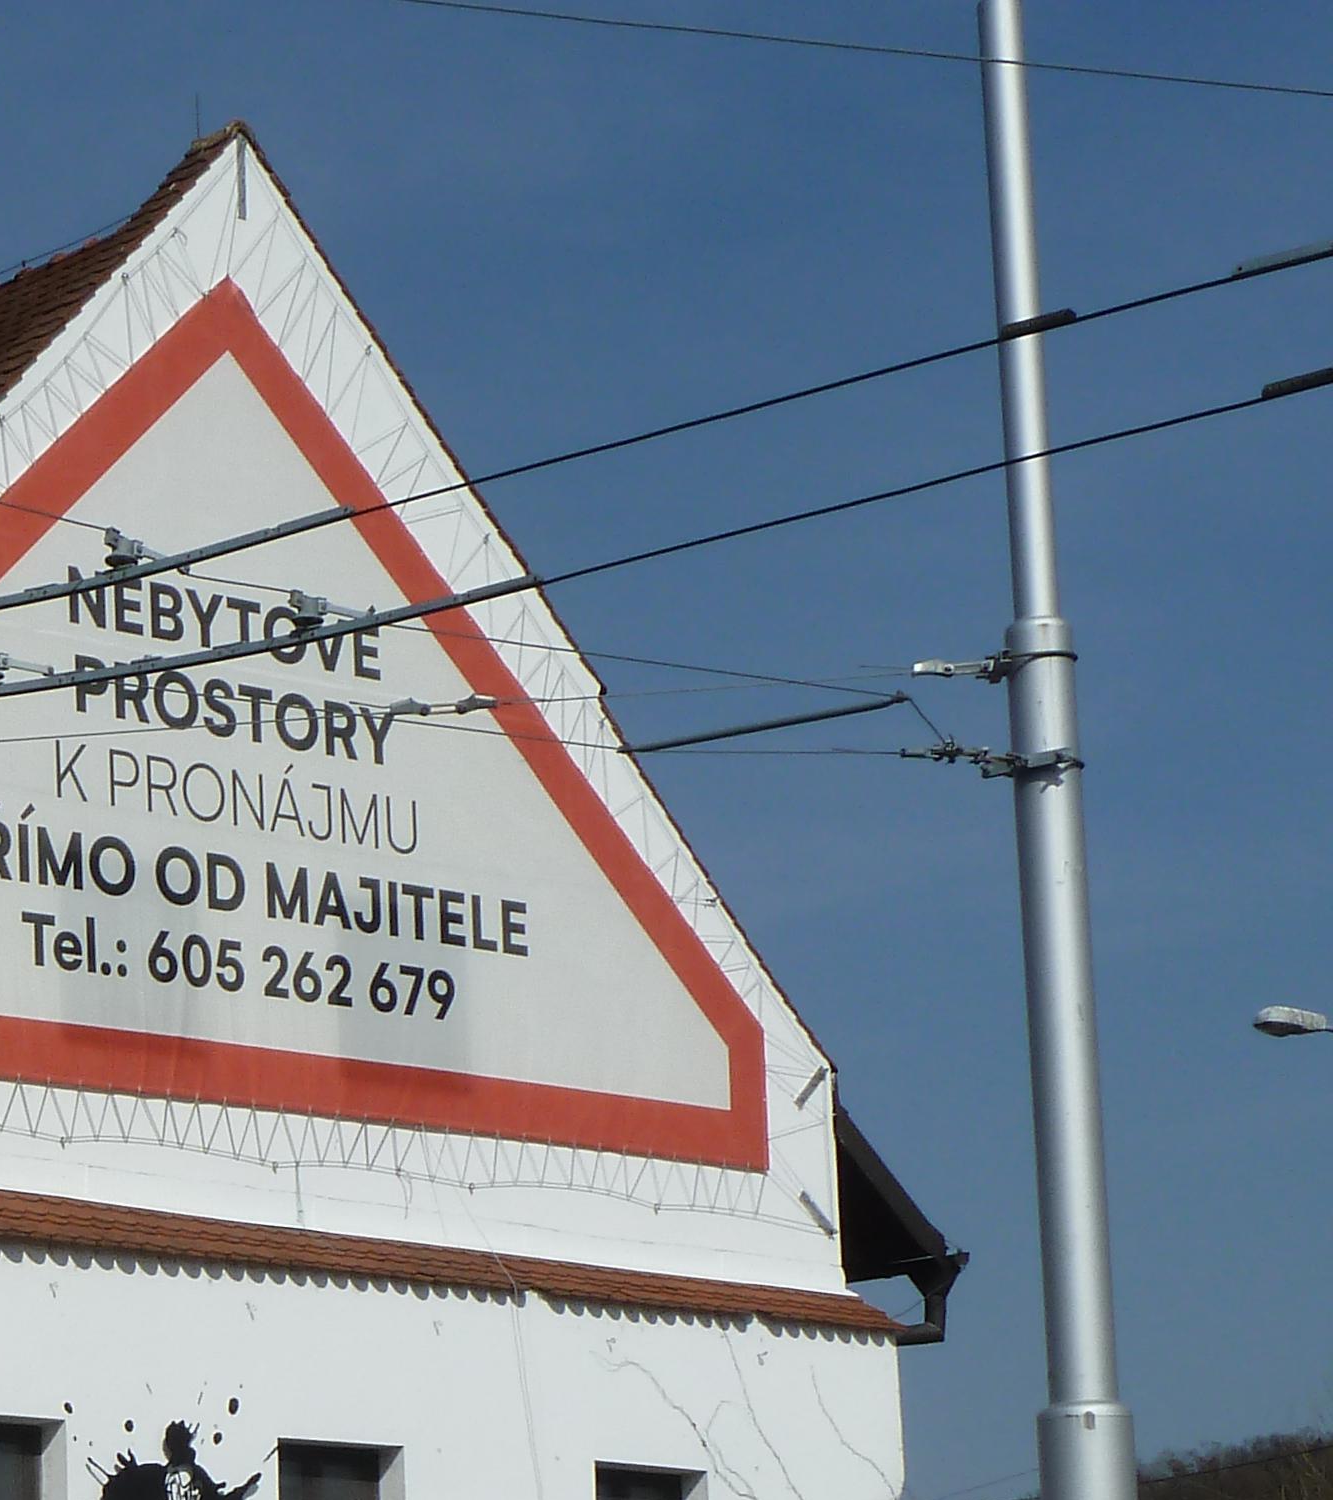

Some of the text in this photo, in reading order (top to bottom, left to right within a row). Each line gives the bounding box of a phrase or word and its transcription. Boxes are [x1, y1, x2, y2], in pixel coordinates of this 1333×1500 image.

[68, 566, 381, 680] NEBYTOVÉ
[75, 654, 395, 764] PROSTORY
[55, 740, 418, 854] K PRONÁJMU
[156, 846, 247, 912] OD
[266, 862, 530, 958] MAJITELE
[22, 912, 456, 1021] Tel.: 605 262 679
